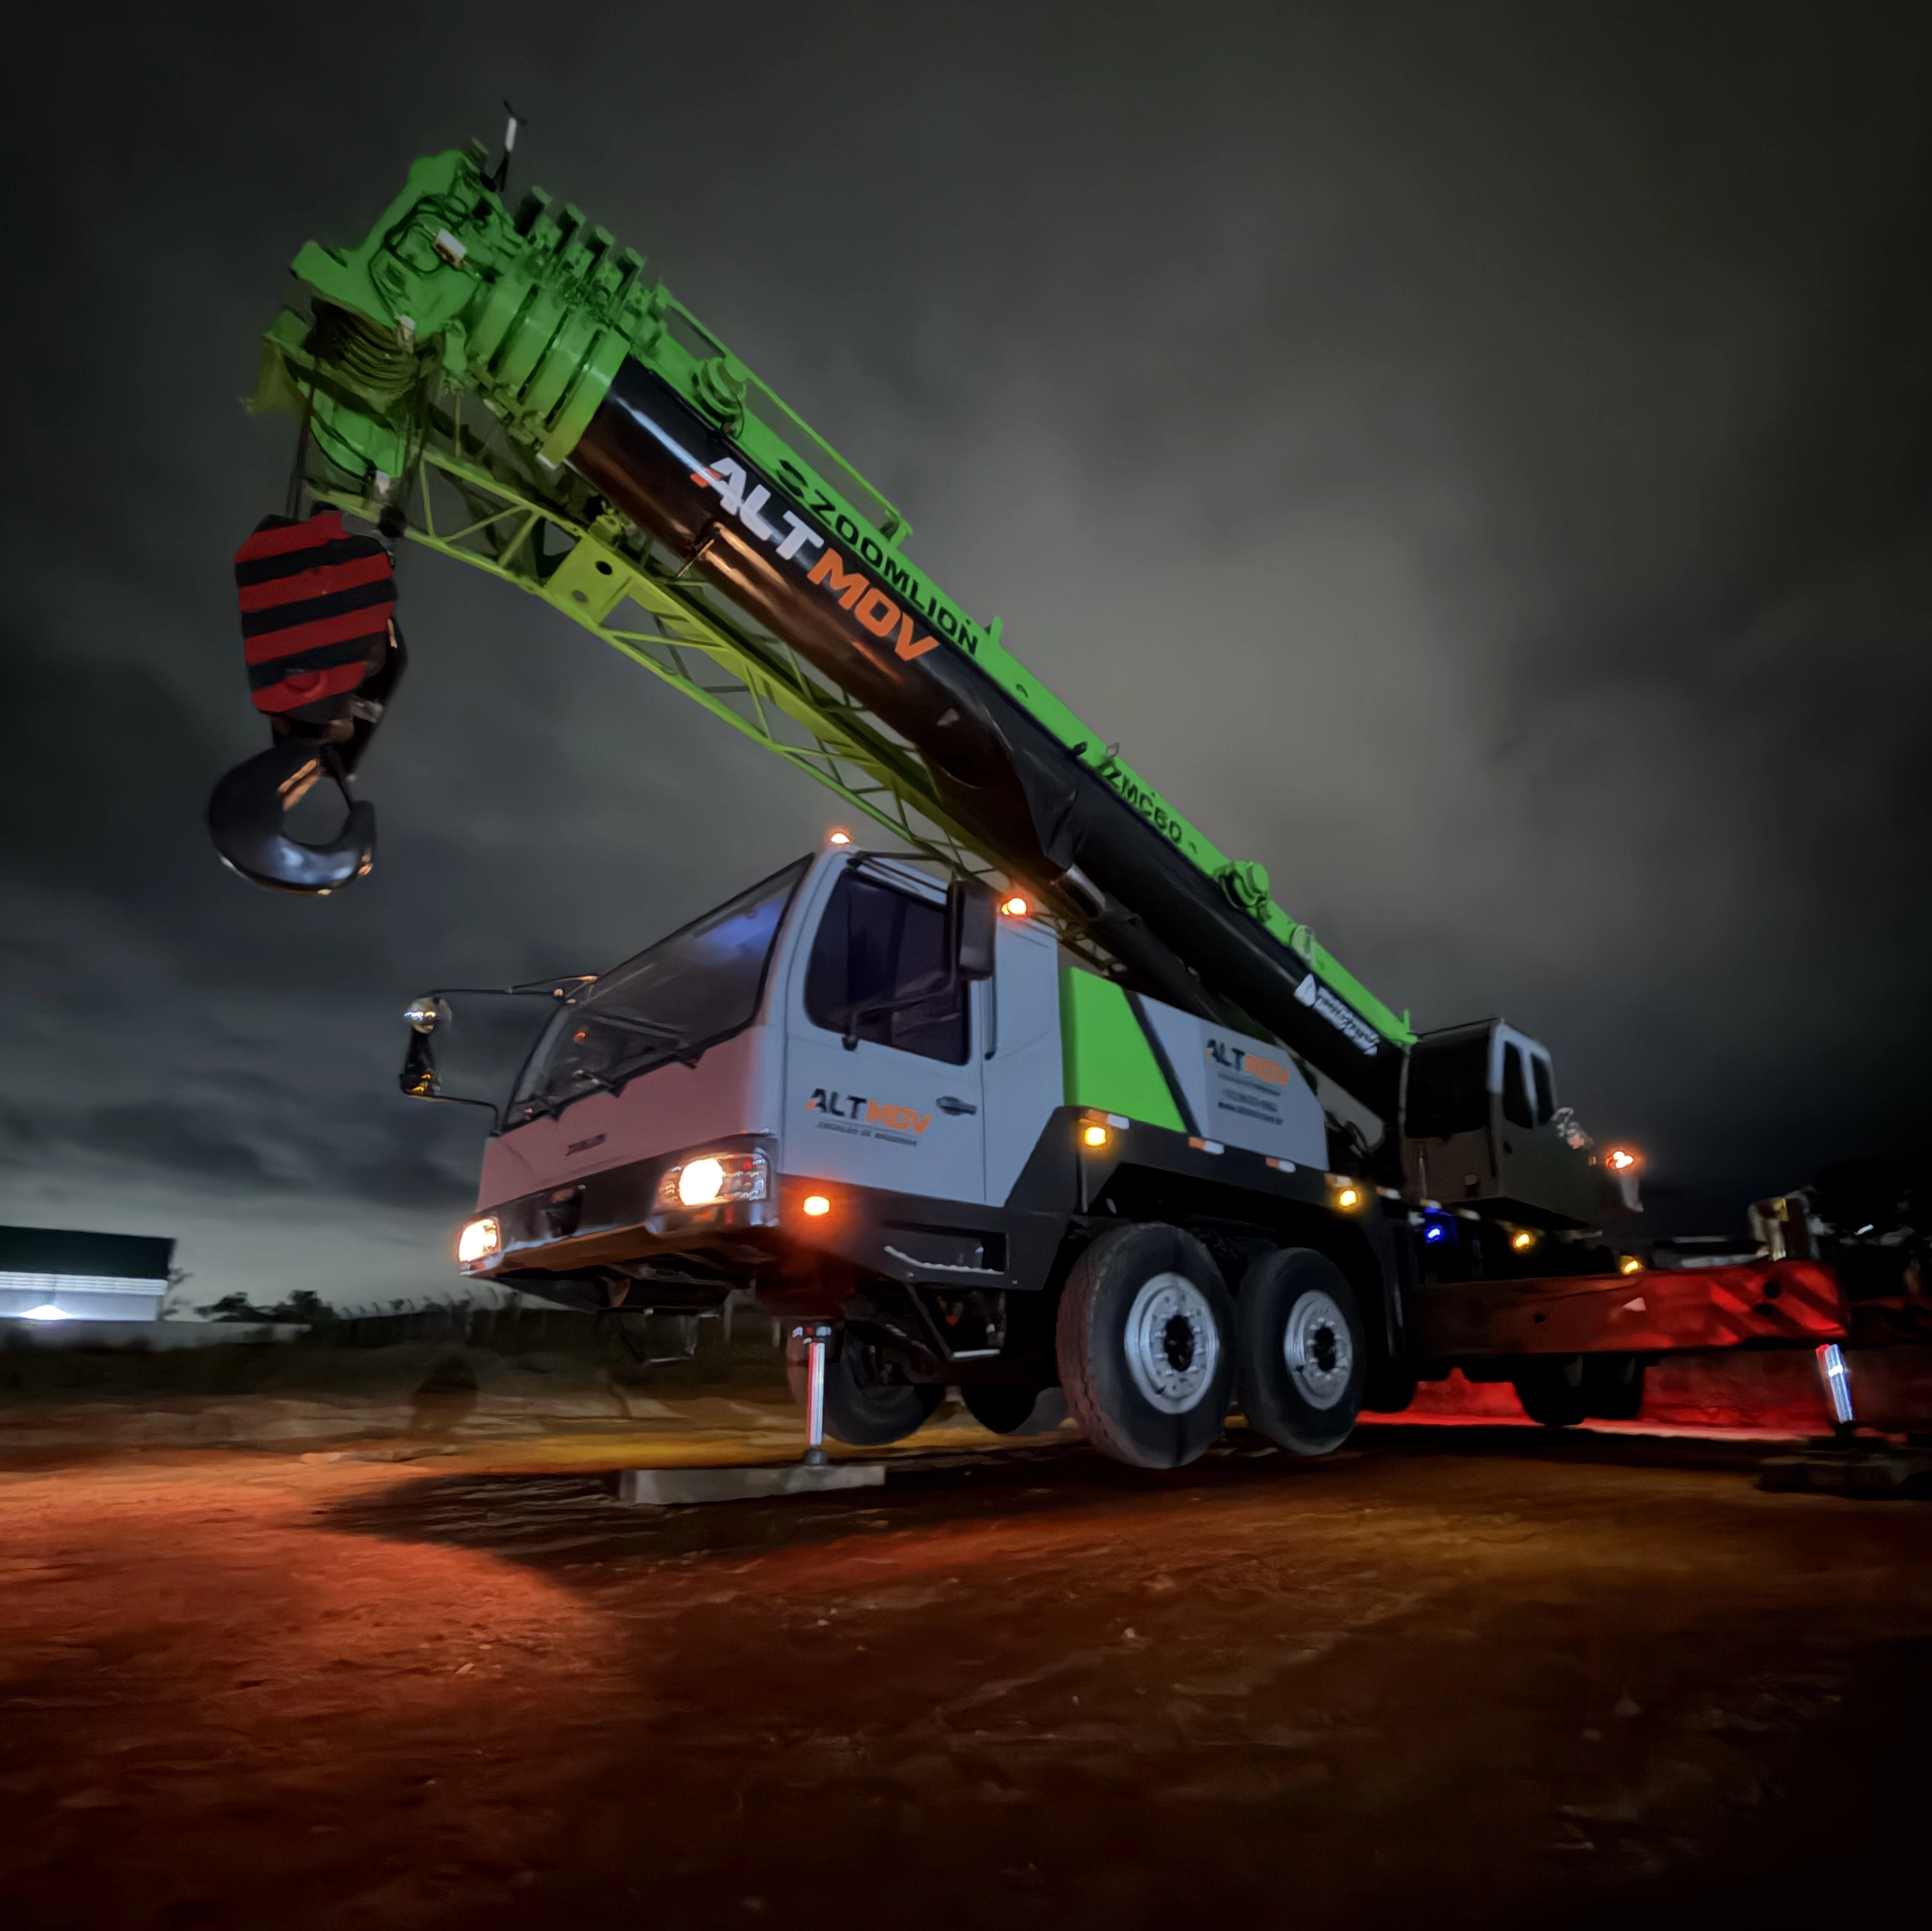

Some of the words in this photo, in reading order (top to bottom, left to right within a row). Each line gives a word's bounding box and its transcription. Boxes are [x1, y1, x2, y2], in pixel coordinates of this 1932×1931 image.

[690, 456, 940, 662] ALTMOV
[809, 489, 979, 656] ZOOMLION
[804, 1088, 932, 1134] ALTMOV
